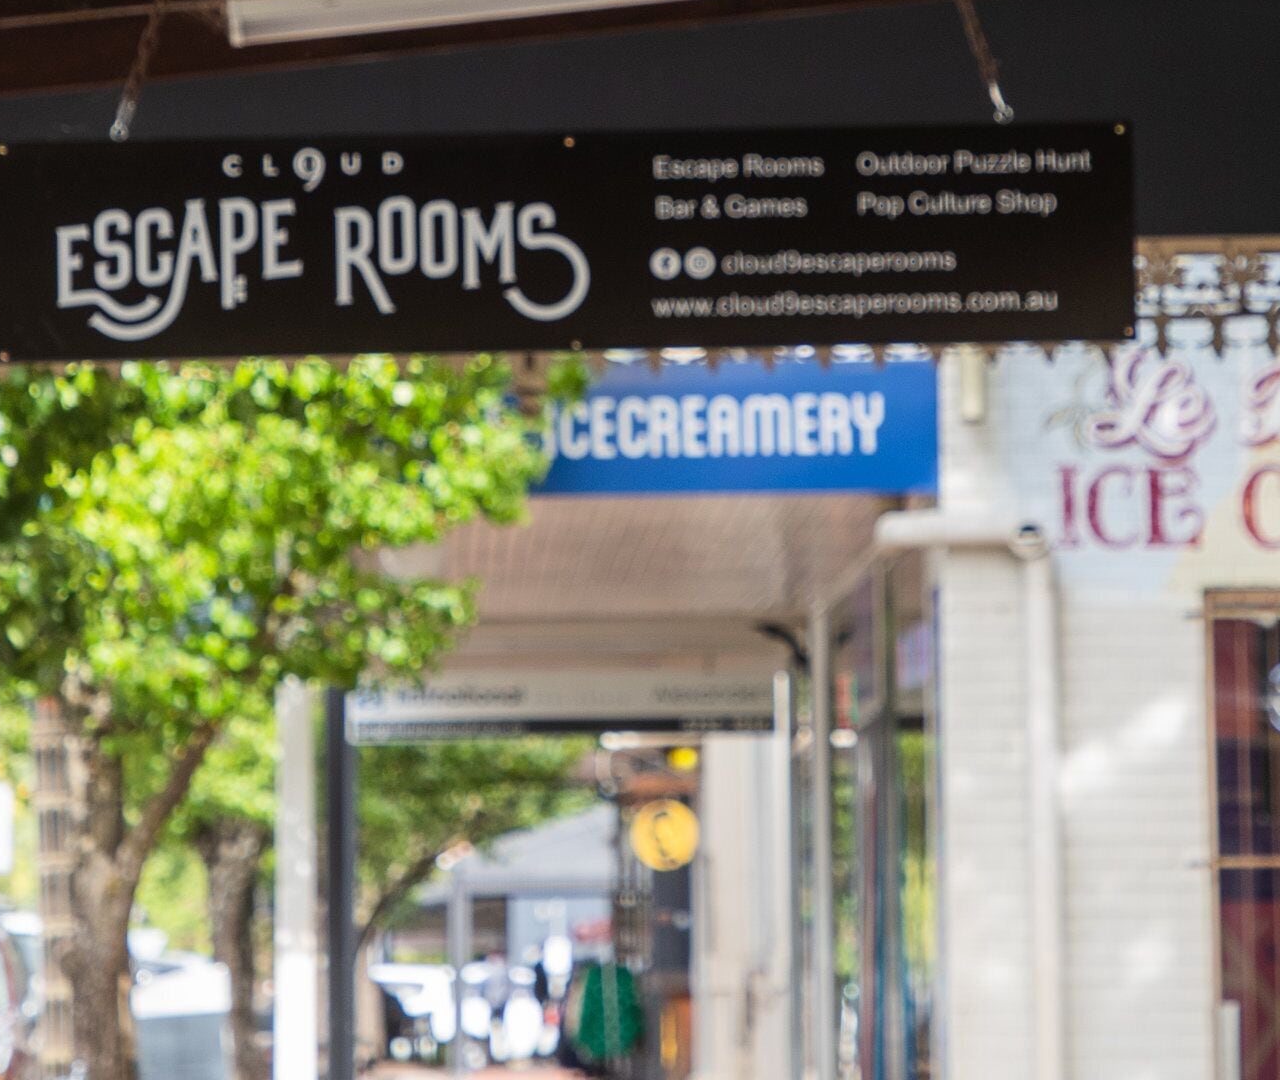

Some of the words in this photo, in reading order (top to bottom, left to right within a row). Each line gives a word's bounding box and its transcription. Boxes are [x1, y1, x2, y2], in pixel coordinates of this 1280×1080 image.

[652, 154, 739, 182] Escape
[742, 153, 825, 178] Rooms
[856, 150, 950, 176] Outdoor
[953, 148, 1032, 174] Puzzle
[1035, 148, 1092, 173] Hunt
[654, 195, 697, 220] Bar
[700, 193, 721, 219] &
[723, 193, 808, 219] Games
[856, 190, 905, 220] Pop
[907, 189, 992, 216] Culture
[994, 188, 1058, 218] Shop
[56, 196, 304, 341] ESCAPE
[334, 196, 590, 321] ROOMS
[1054, 463, 1202, 551] ICE
